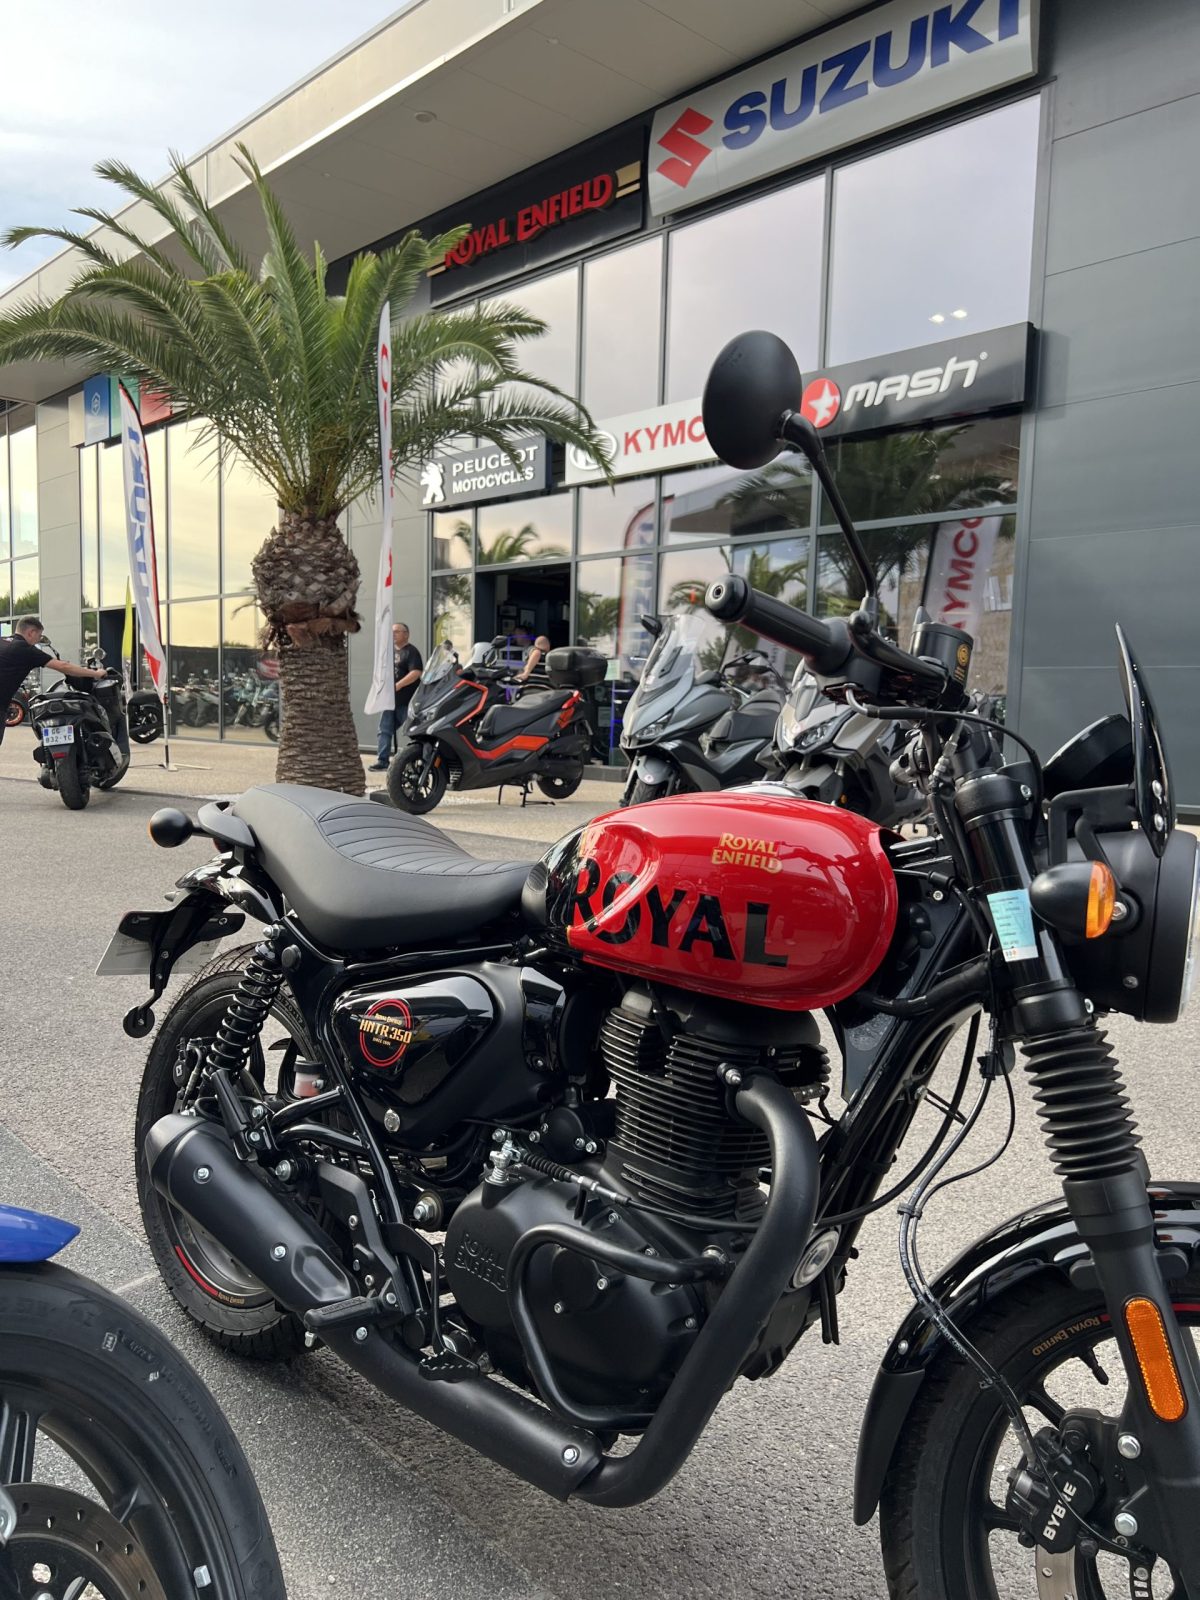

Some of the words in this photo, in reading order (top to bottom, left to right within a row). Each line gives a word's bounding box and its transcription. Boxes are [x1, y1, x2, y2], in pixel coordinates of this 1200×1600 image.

[721, 0, 1019, 150] SUZUKI
[517, 174, 613, 241] ENFIELD
[624, 415, 707, 455] KYMC
[452, 466, 534, 494] MOTOCYCLES
[719, 832, 779, 856] ROYAL
[711, 848, 783, 874] ENFIELD
[563, 857, 789, 968] ROYAL
[389, 1027, 412, 1044] 350
[1067, 1316, 1101, 1334] ROYAL
[1032, 1330, 1069, 1356] ENFIELD
